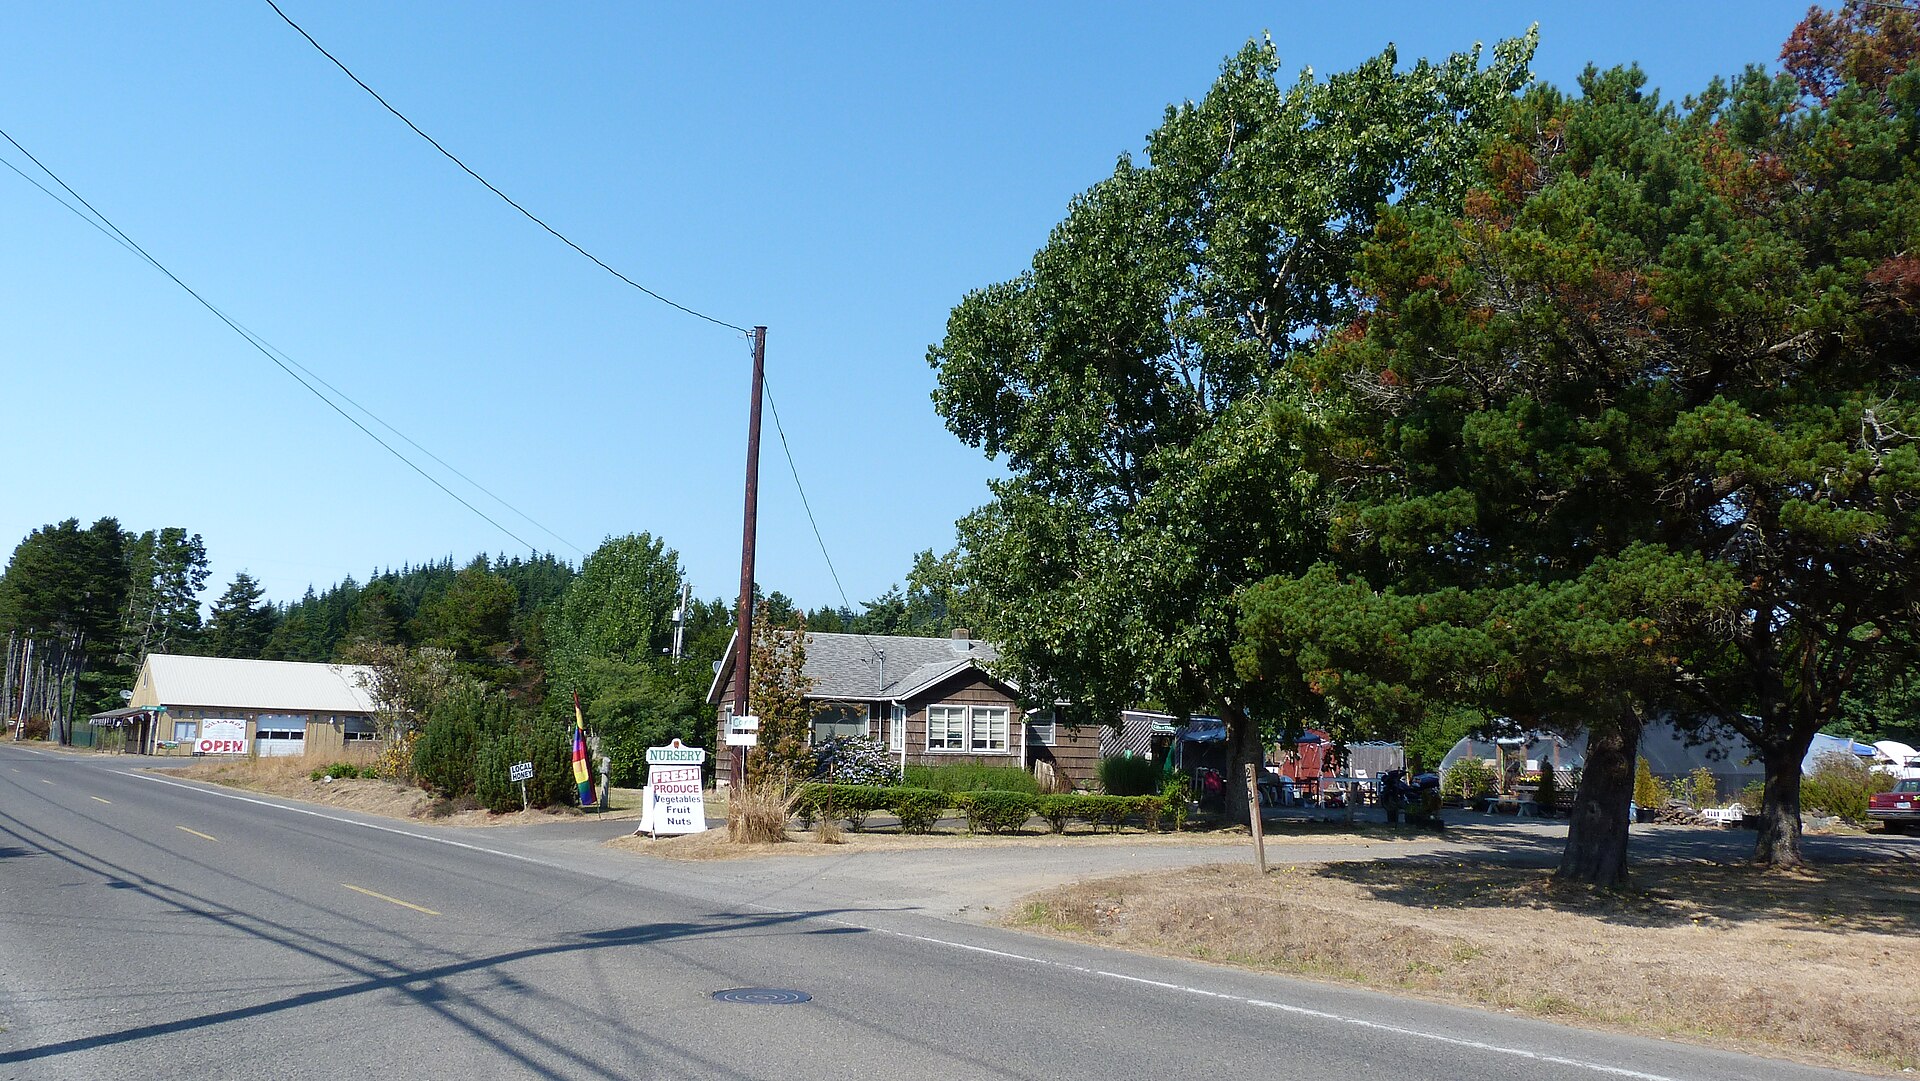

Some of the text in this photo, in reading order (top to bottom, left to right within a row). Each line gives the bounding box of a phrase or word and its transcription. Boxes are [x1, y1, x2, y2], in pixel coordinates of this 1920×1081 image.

[200, 740, 243, 752] OPEN
[650, 750, 702, 761] NURSERY
[512, 763, 532, 774] LOCAL
[512, 770, 532, 780] HONEY
[652, 768, 699, 784] FRESH
[654, 784, 699, 793] PRODUCE
[655, 795, 701, 804] Vegetables
[666, 806, 691, 814] Fruit
